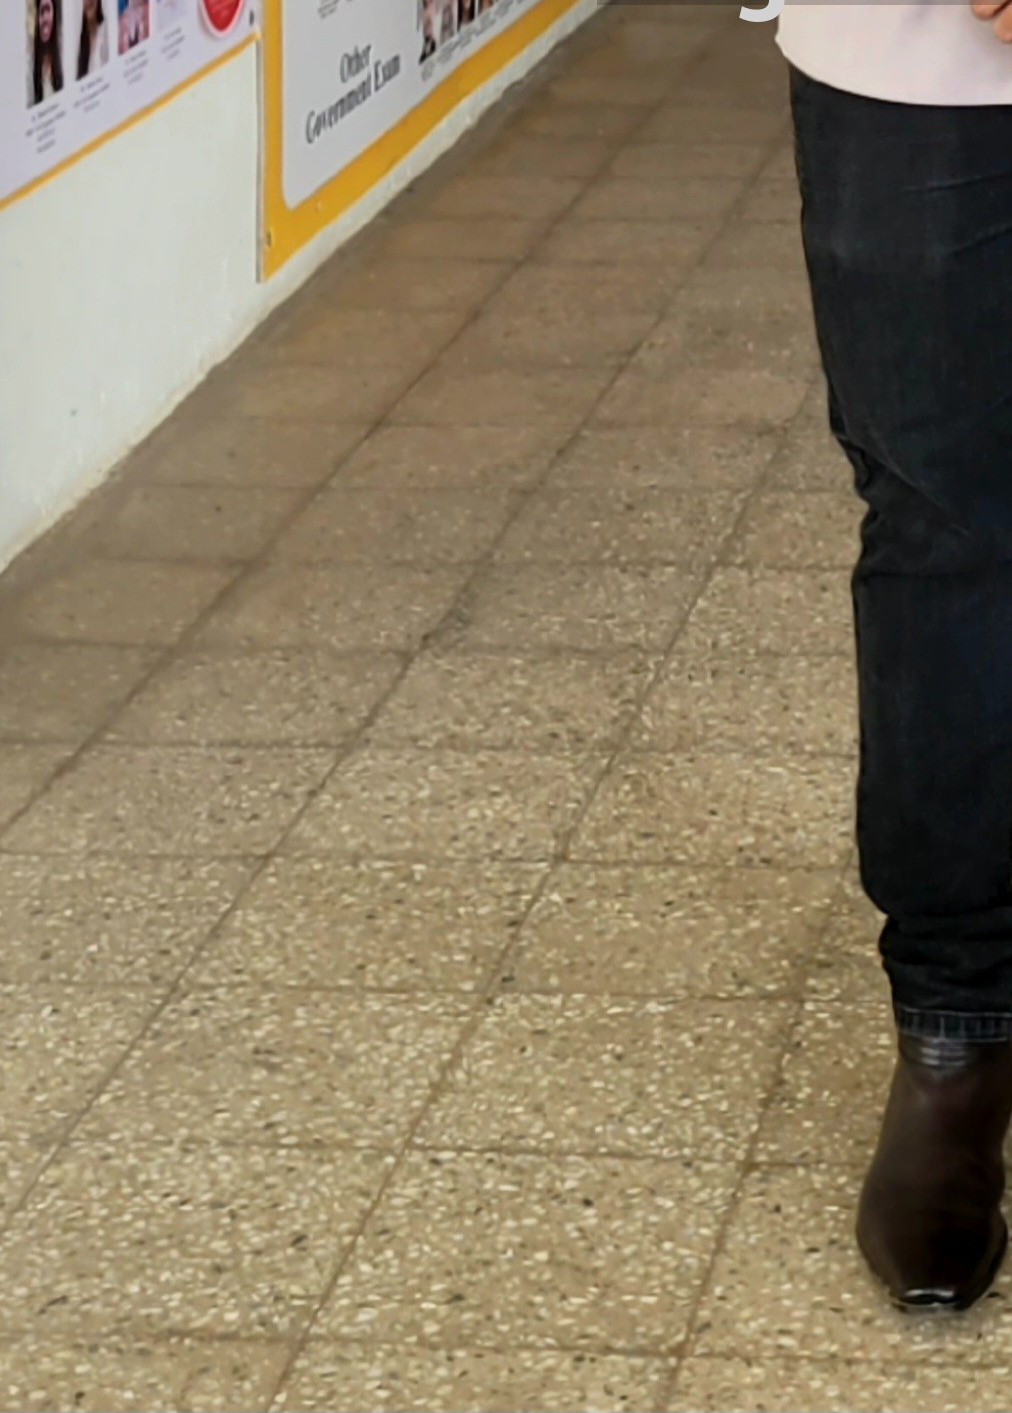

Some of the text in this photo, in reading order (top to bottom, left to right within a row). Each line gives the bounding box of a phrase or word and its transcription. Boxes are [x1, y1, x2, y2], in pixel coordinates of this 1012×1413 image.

[340, 44, 371, 84] Other
[305, 54, 400, 144] Government Exam
